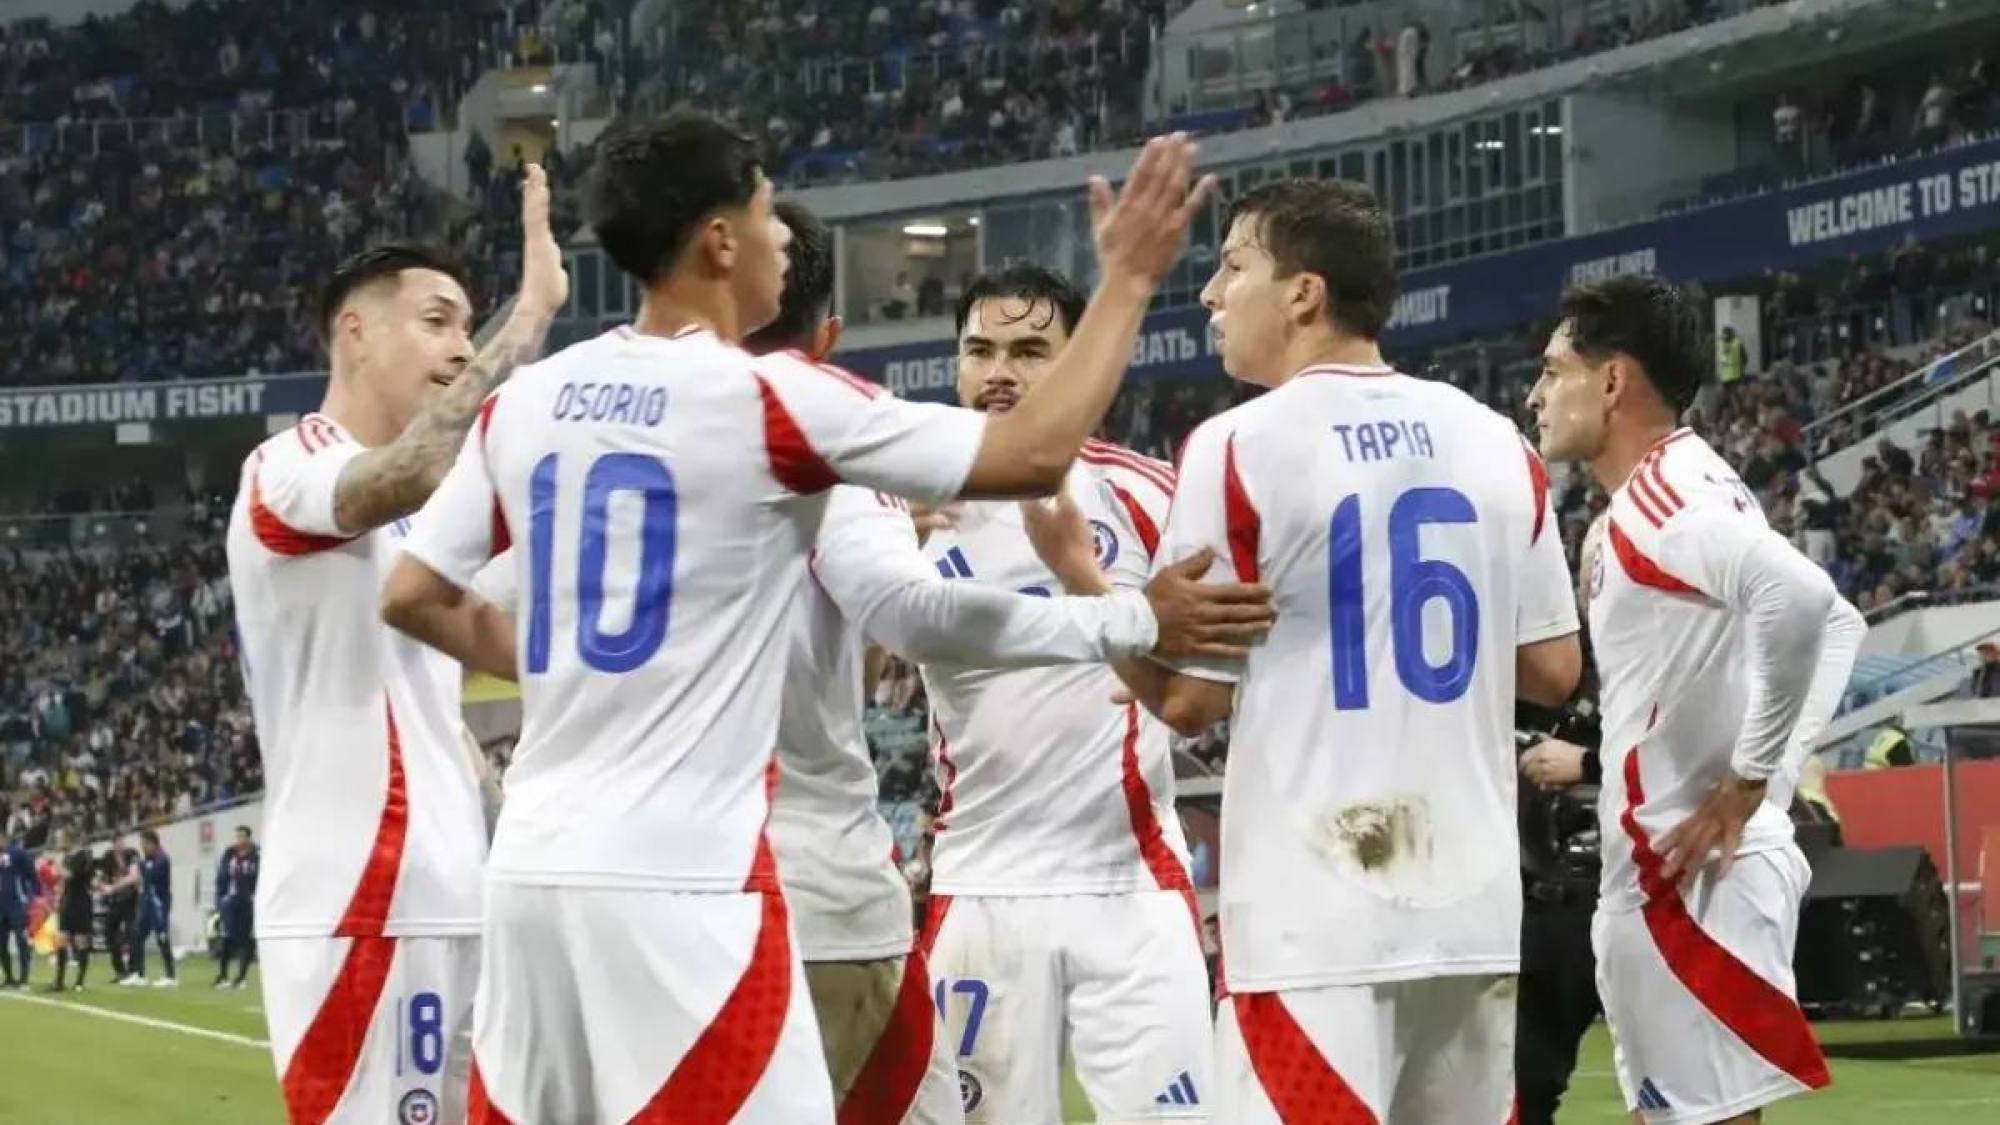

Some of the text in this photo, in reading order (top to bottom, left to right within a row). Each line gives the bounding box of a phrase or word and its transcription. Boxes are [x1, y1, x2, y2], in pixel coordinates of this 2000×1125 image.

[1787, 182, 1913, 246] WELCOME
[1917, 174, 1952, 217] TO
[0, 382, 265, 427] STADIUM FISHT
[553, 382, 667, 427] OSORIO
[1333, 421, 1434, 462] TAPIA
[526, 452, 677, 673] 10
[1329, 487, 1479, 710] 16
[397, 992, 443, 1077] 8
